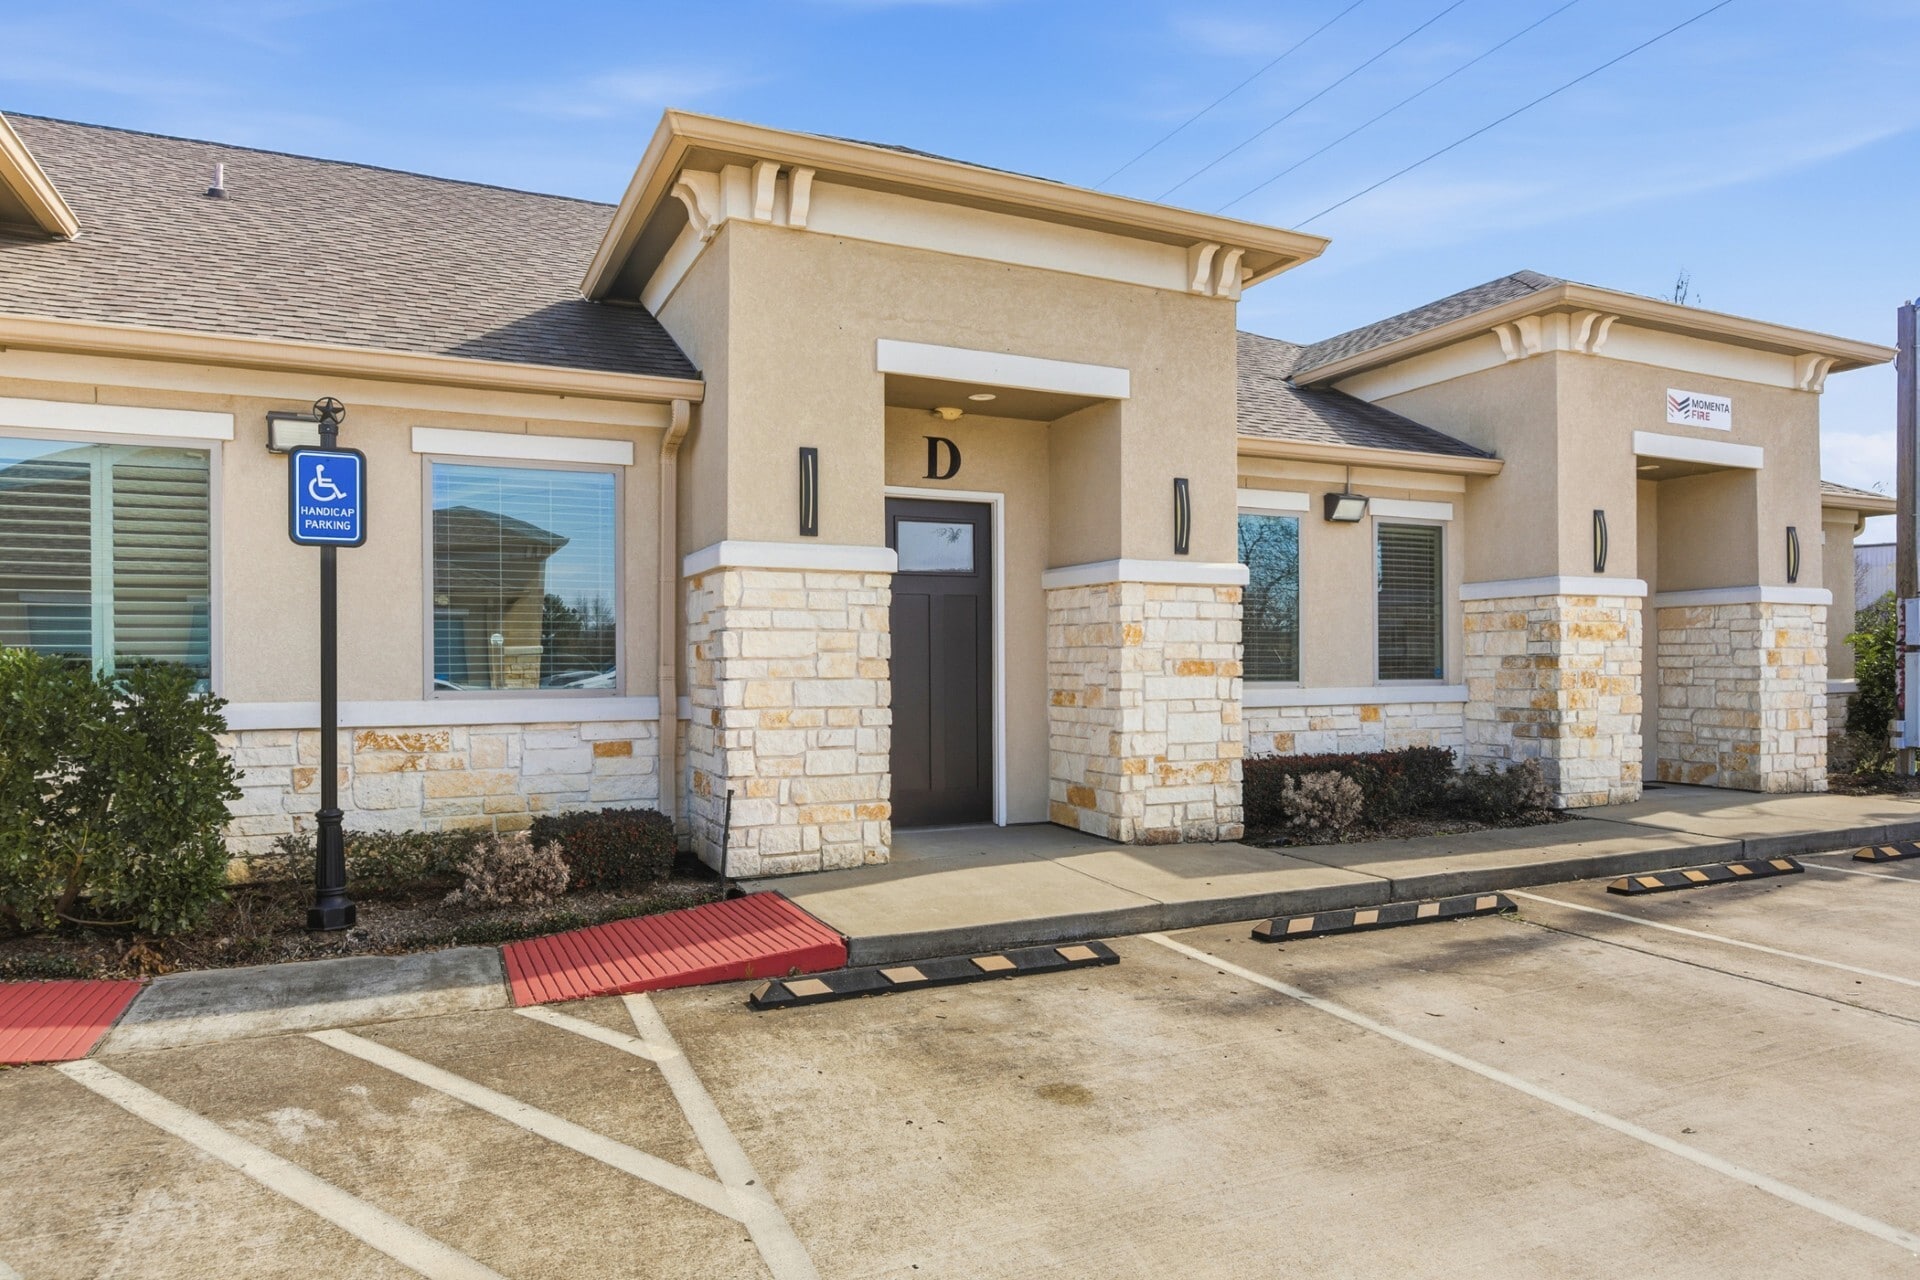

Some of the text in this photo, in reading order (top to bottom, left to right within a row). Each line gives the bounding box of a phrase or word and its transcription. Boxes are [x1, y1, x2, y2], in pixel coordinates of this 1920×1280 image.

[1691, 399, 1730, 413] MOMENTA
[1691, 409, 1711, 421] FIRE
[922, 435, 962, 480] D
[300, 505, 355, 518] HANDICAP
[305, 519, 351, 531] PARKING
